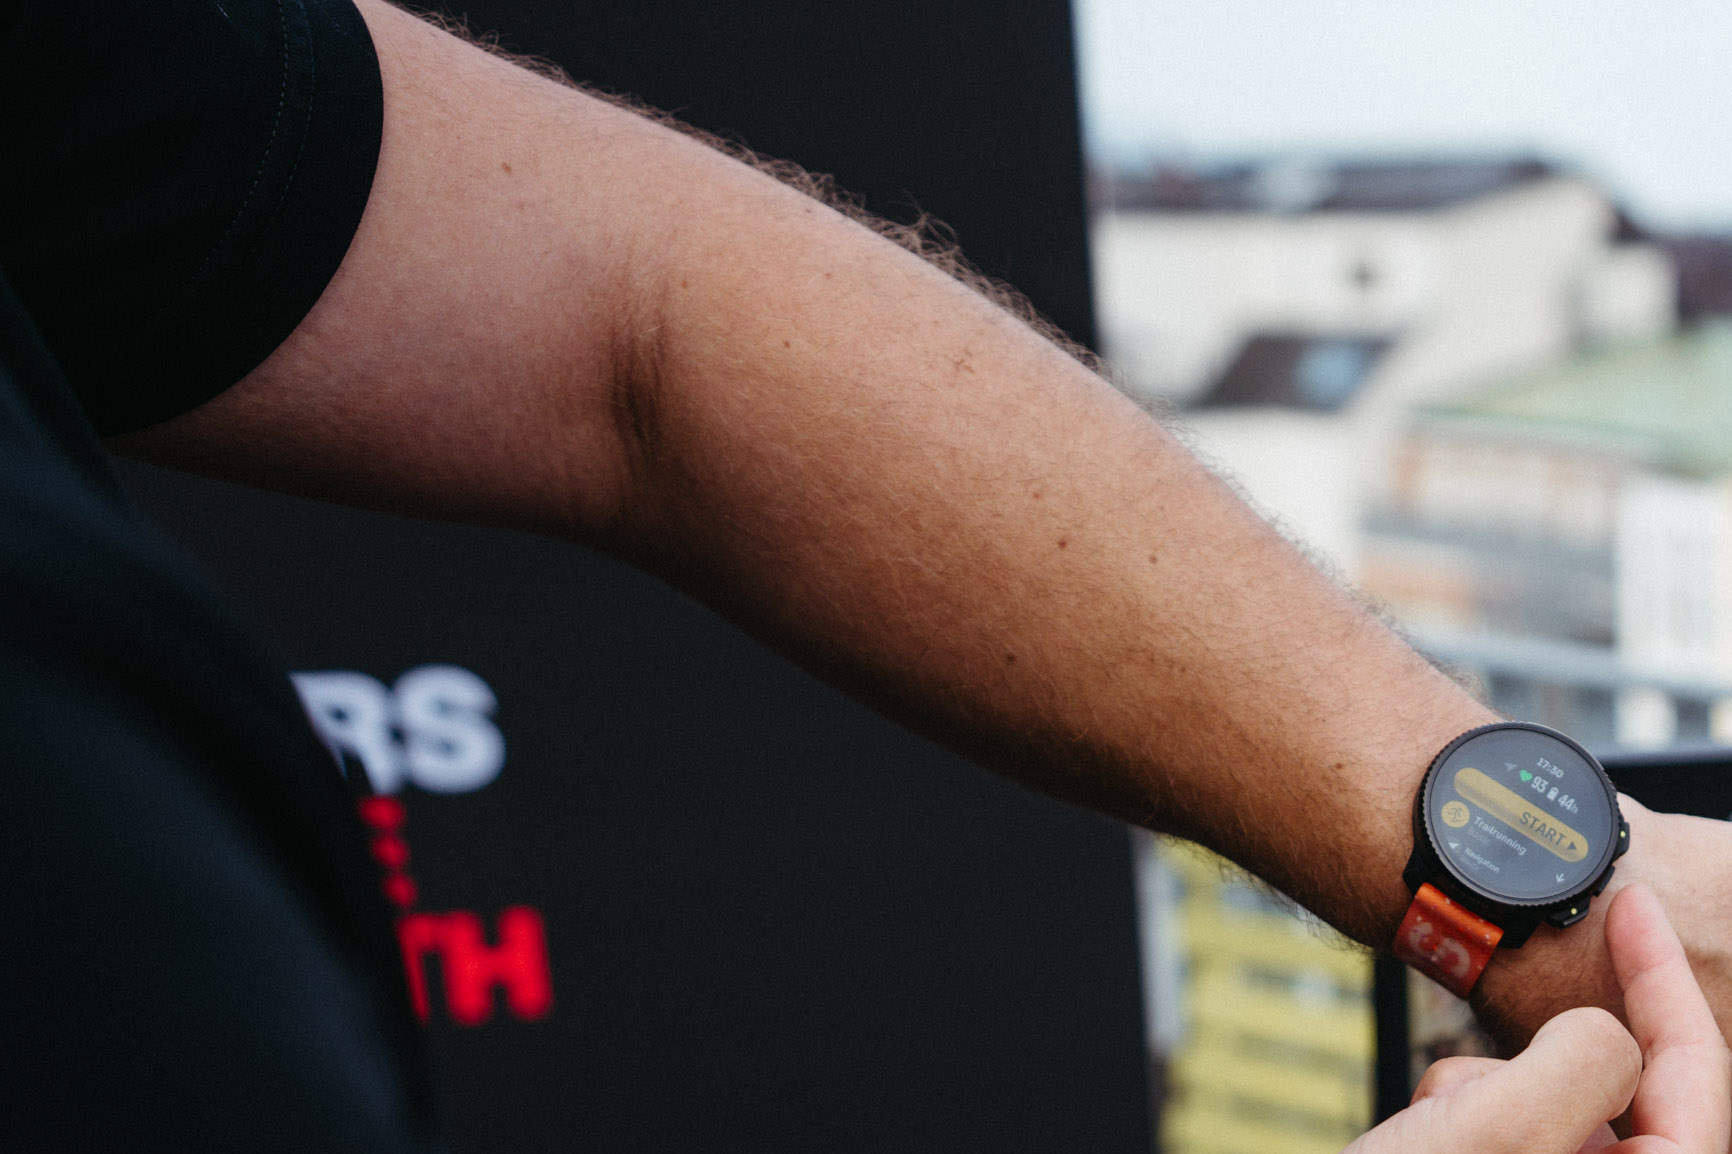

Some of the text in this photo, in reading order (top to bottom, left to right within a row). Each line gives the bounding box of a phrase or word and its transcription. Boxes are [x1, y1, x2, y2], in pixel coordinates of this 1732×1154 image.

[1536, 757, 1564, 778] 17:30
[1531, 776, 1549, 793] 93
[1474, 816, 1527, 856] Trailrunning
[1519, 811, 1567, 846] START
[1464, 847, 1500, 873] Navigation
